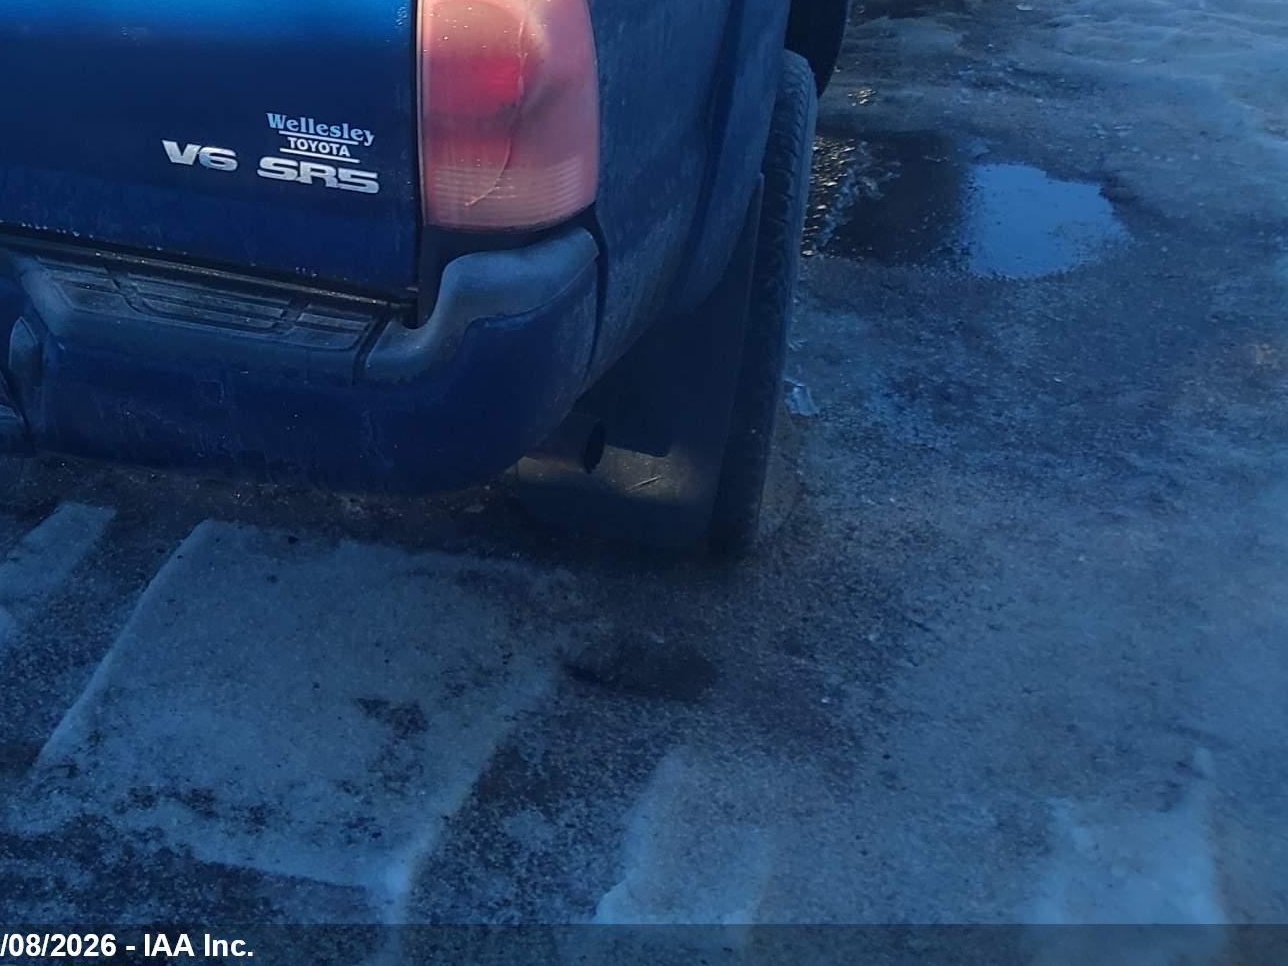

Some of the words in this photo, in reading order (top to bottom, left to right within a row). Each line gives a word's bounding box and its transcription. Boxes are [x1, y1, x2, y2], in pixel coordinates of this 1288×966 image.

[265, 112, 375, 146] Wellesley
[287, 136, 352, 158] TOYOTA
[162, 139, 238, 171] V6
[257, 156, 380, 194] SR5
